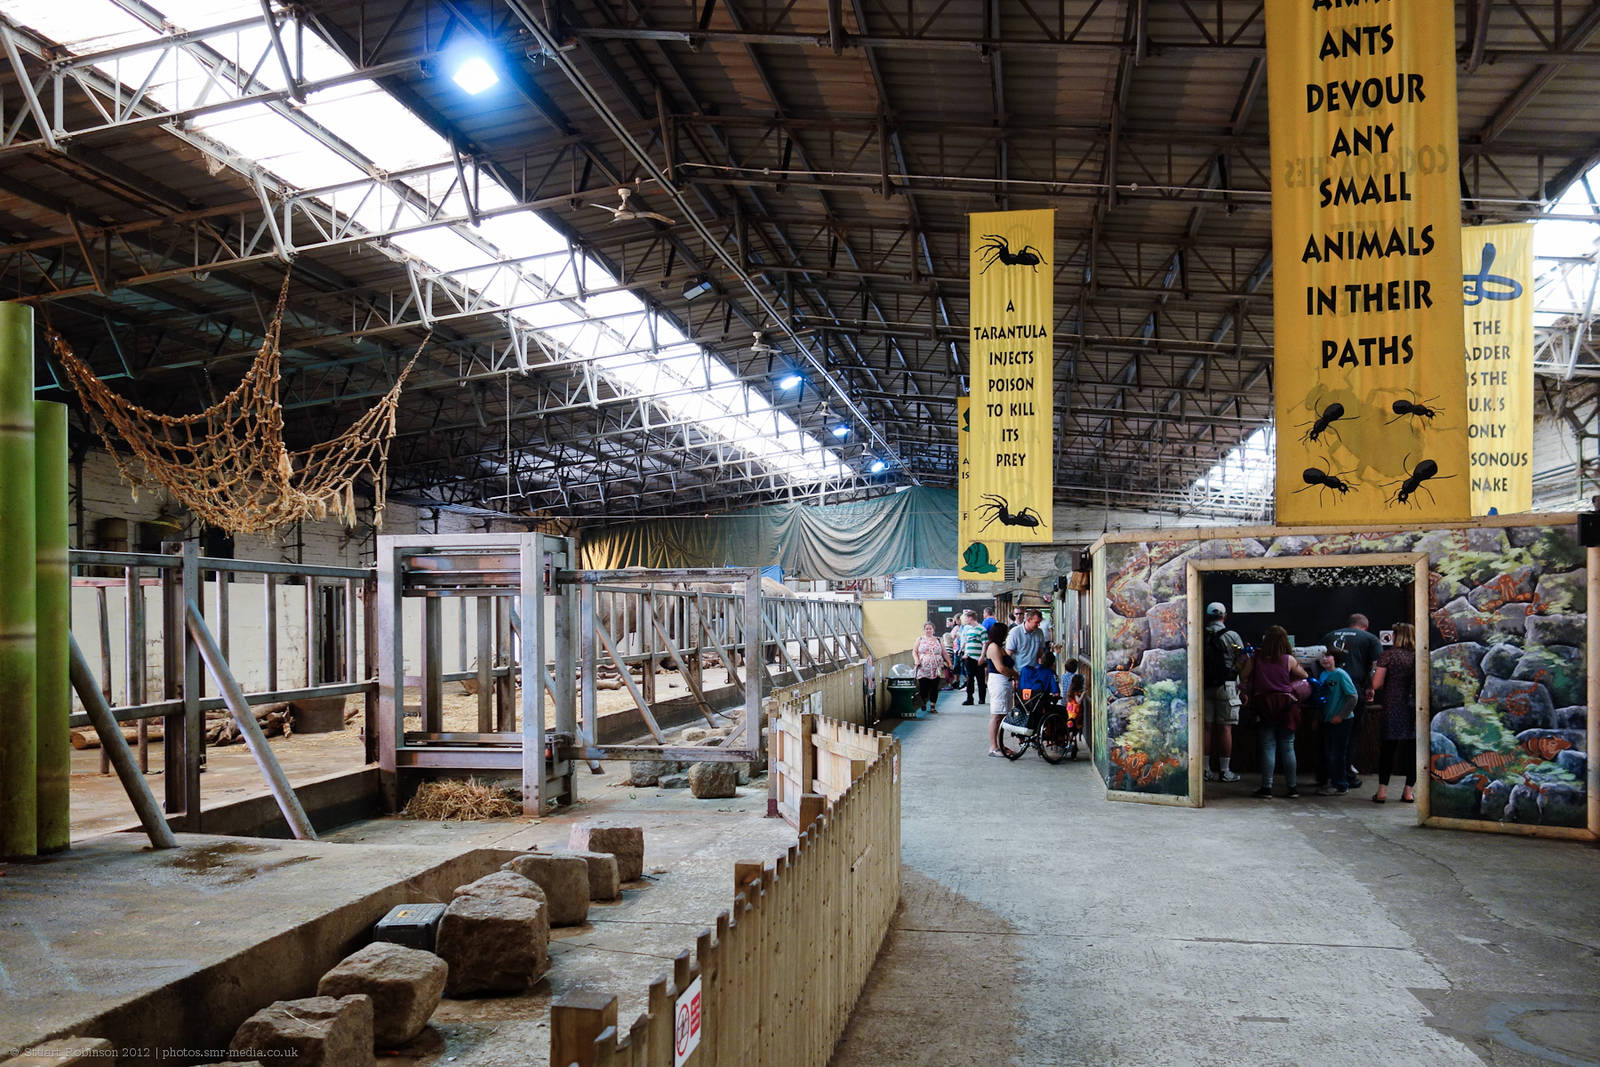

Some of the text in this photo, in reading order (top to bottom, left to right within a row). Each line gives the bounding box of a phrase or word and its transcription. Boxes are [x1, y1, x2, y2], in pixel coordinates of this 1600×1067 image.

[1319, 24, 1394, 61] ANTS
[1307, 73, 1426, 113] DEVOUR
[1331, 123, 1394, 158] ANY
[1320, 172, 1411, 208] SMALL
[1302, 225, 1434, 263] ANIMALS
[1307, 286, 1336, 315] IN
[1345, 280, 1433, 313] THEIR
[1006, 299, 1015, 312] A
[974, 325, 1047, 340] TARANTULA
[1473, 320, 1501, 335] THE
[989, 351, 1034, 366] INJECTS
[1322, 335, 1413, 368] PATHS
[988, 377, 1034, 392] POISON
[1481, 371, 1507, 386] THE
[987, 402, 1035, 417] TO KILL
[1002, 428, 1019, 442] ITS
[1468, 424, 1506, 439] ONLY
[996, 453, 1026, 467] PREY
[1471, 452, 1528, 467] SONOUS
[1472, 477, 1508, 492] NAKE
